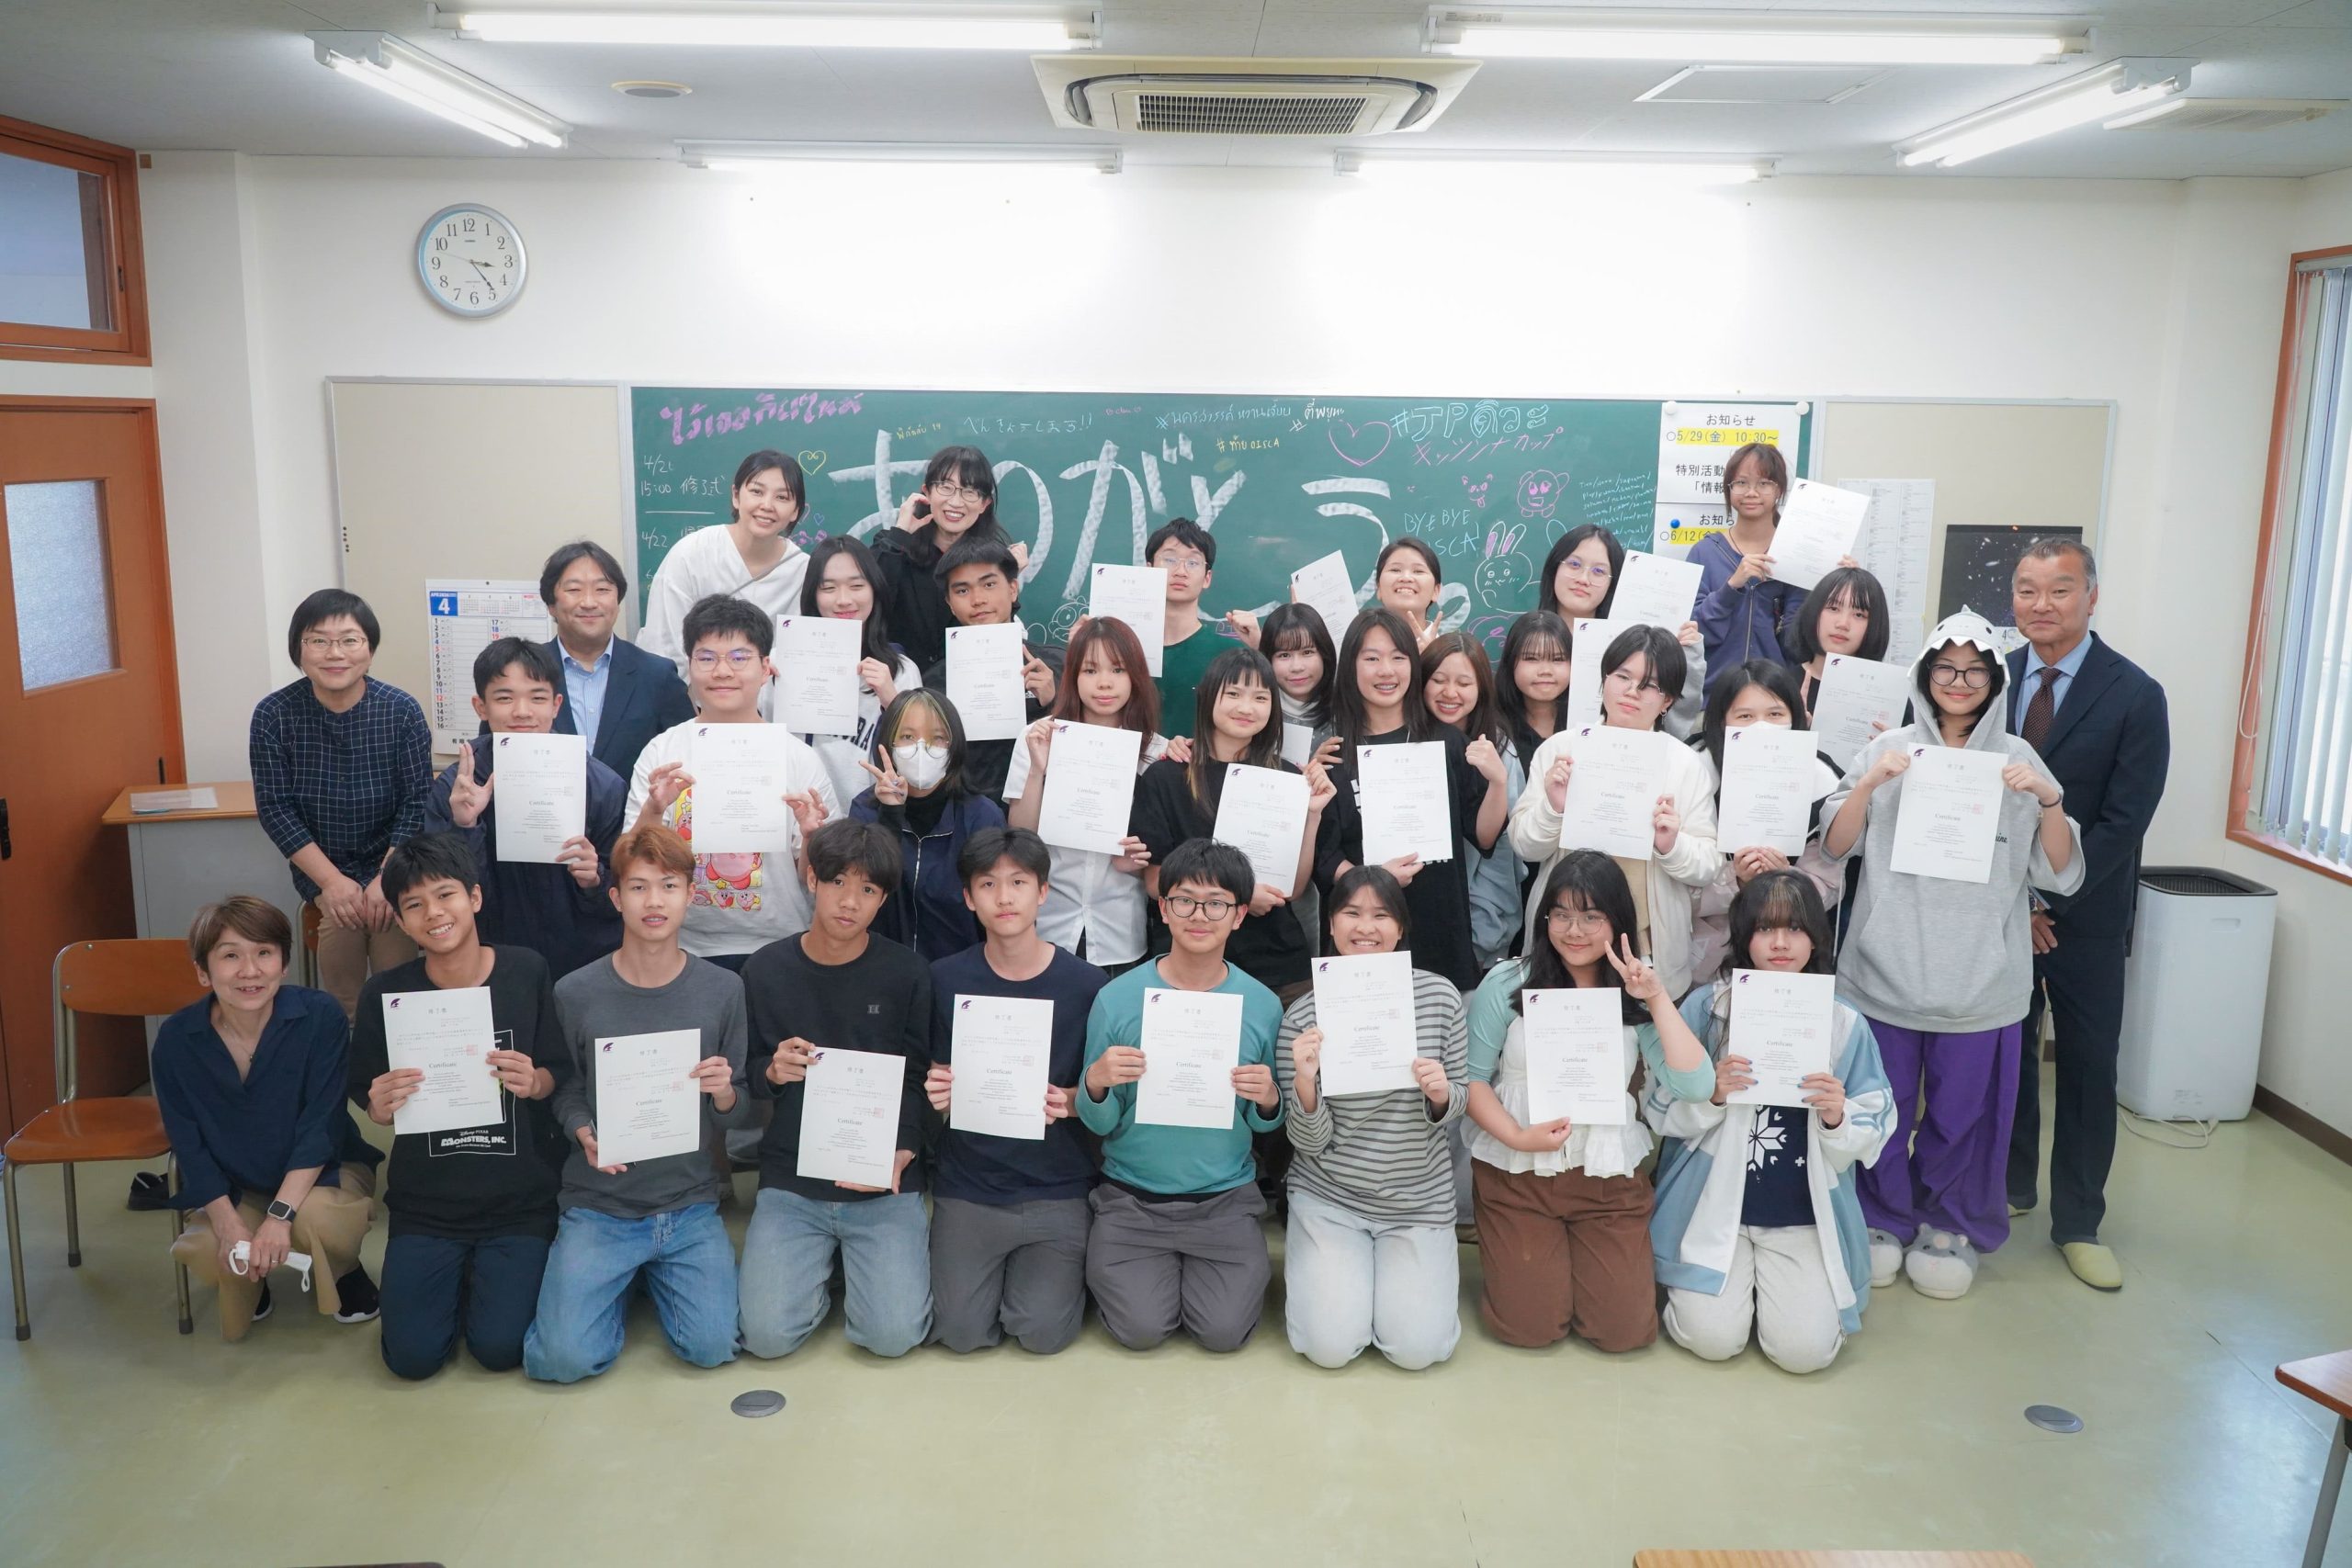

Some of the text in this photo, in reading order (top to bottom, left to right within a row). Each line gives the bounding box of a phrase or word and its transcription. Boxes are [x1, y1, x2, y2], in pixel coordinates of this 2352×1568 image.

[447, 224, 458, 237] 11
[463, 219, 475, 231] 12
[435, 237, 448, 250] 10
[497, 236, 505, 250] 2
[432, 257, 441, 270] 9
[504, 255, 513, 268] 3
[440, 276, 448, 288] 8
[500, 274, 507, 286] 4
[454, 288, 461, 301] 7
[470, 292, 479, 305] 6
[489, 288, 496, 300] 5
[1706, 414, 1756, 426] お知らせ
[1676, 465, 1724, 477] 特別活動
[640, 475, 727, 497] 15:00 修了式
[1404, 509, 1470, 536] BYE BYE
[1700, 514, 1735, 526] お知ら
[641, 527, 668, 549] 4/22
[438, 598, 450, 615] 4
[1766, 1039, 1793, 1047] Certificate
[1176, 1061, 1202, 1069] Certificate
[636, 1099, 662, 1107] Certificate
[837, 1118, 863, 1126] Certificate
